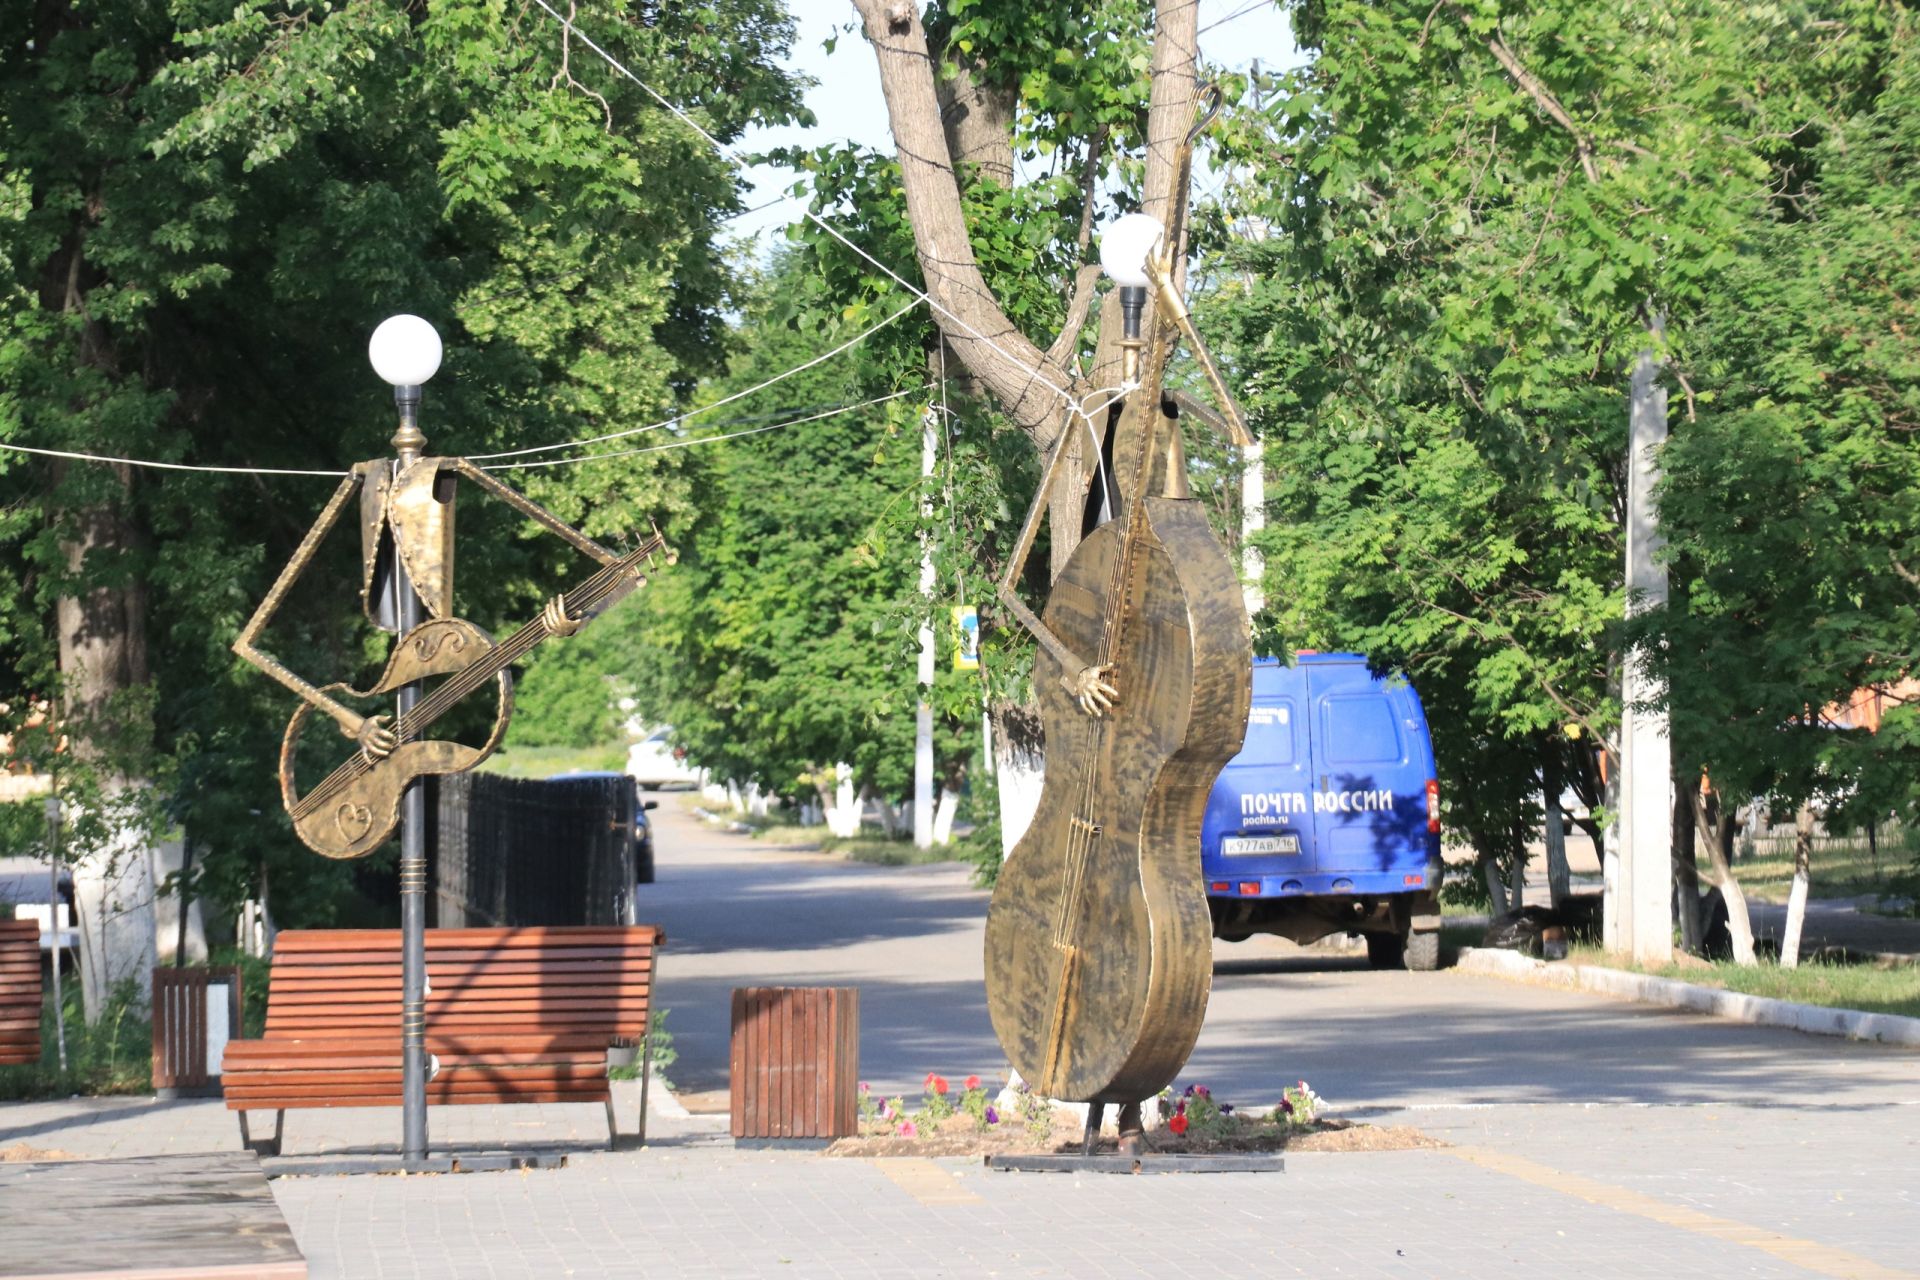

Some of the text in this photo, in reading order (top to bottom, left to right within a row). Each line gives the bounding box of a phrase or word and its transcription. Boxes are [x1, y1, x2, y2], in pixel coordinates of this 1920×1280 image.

[1241, 789, 1393, 815] ПОЧТА РОССИИ
[1242, 814, 1289, 828] pochta.ru
